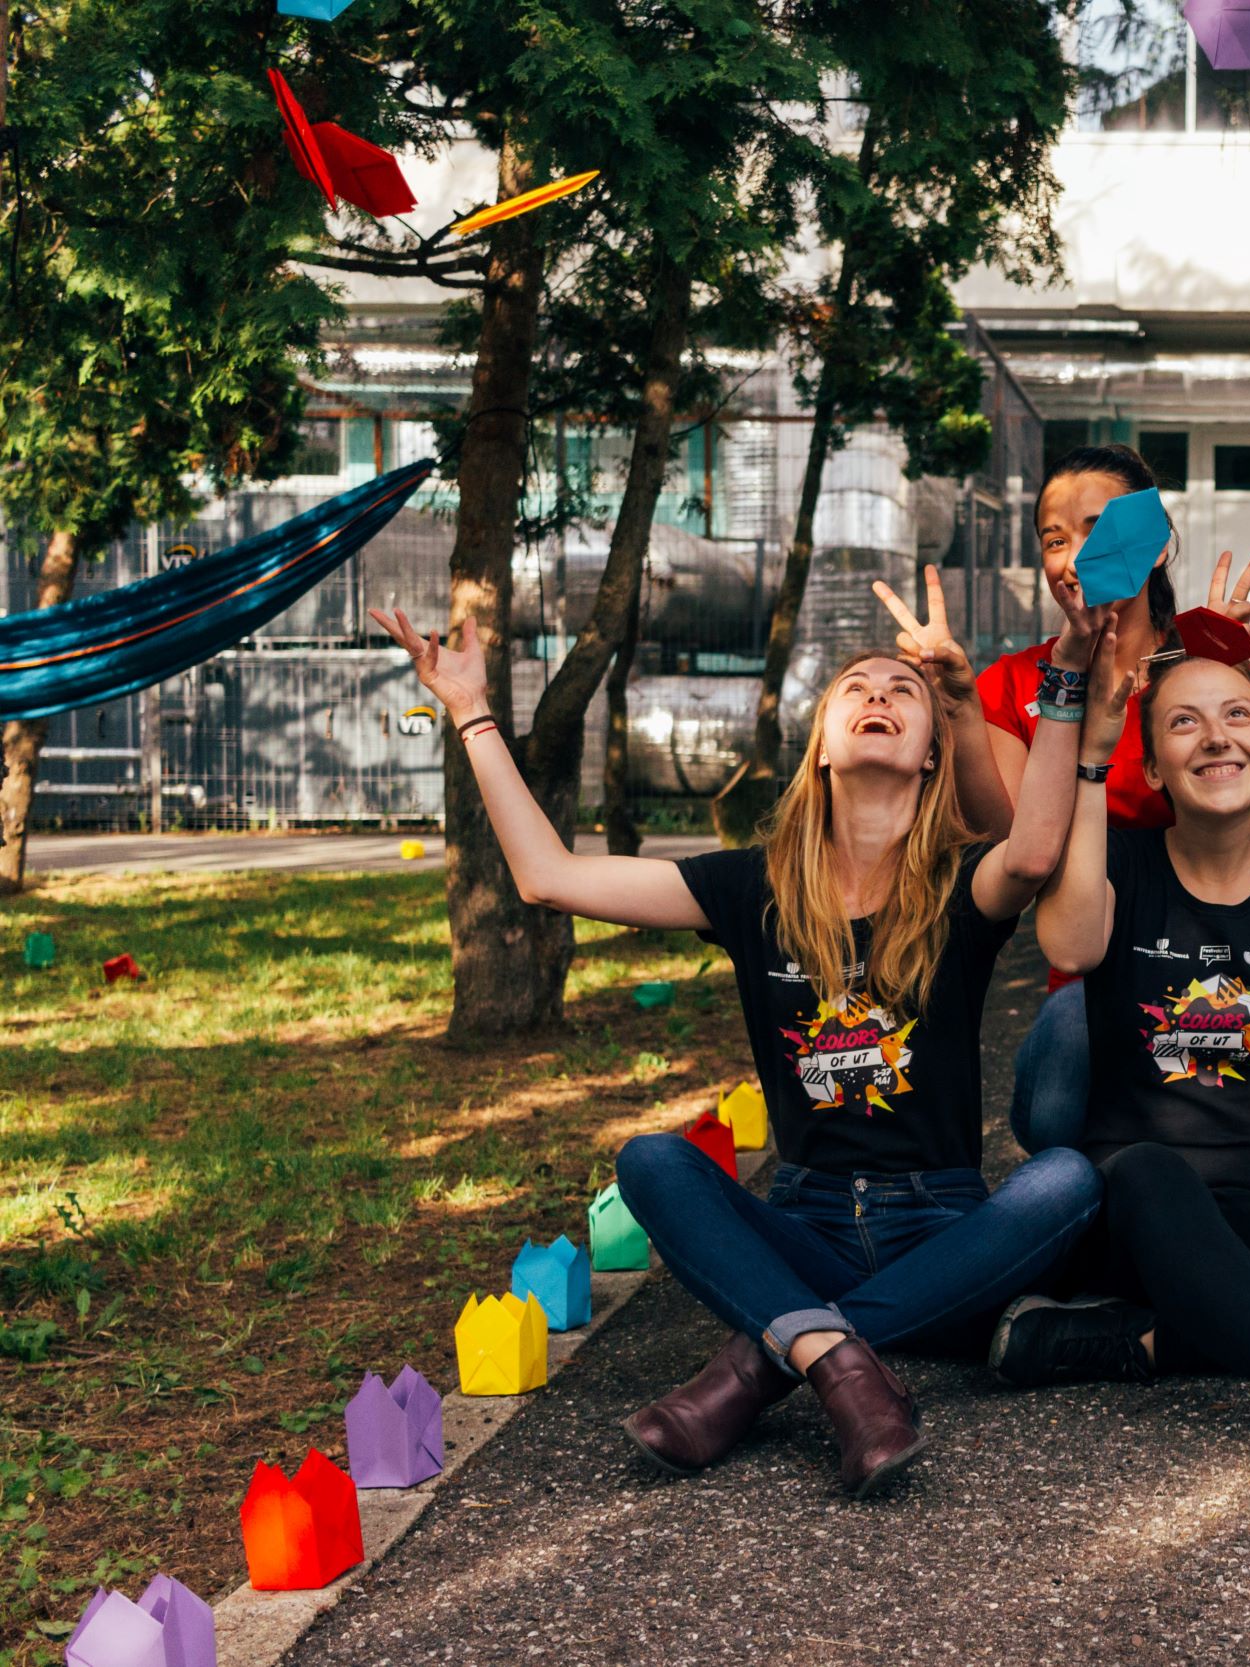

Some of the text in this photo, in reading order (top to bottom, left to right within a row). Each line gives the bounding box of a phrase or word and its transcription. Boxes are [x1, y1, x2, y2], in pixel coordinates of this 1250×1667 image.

[1179, 1012, 1245, 1030] COLORS
[816, 1028, 879, 1050] COLORS
[1189, 1035, 1231, 1046] OF UT
[830, 1052, 869, 1068] OF UT
[875, 1077, 891, 1085] MAI
